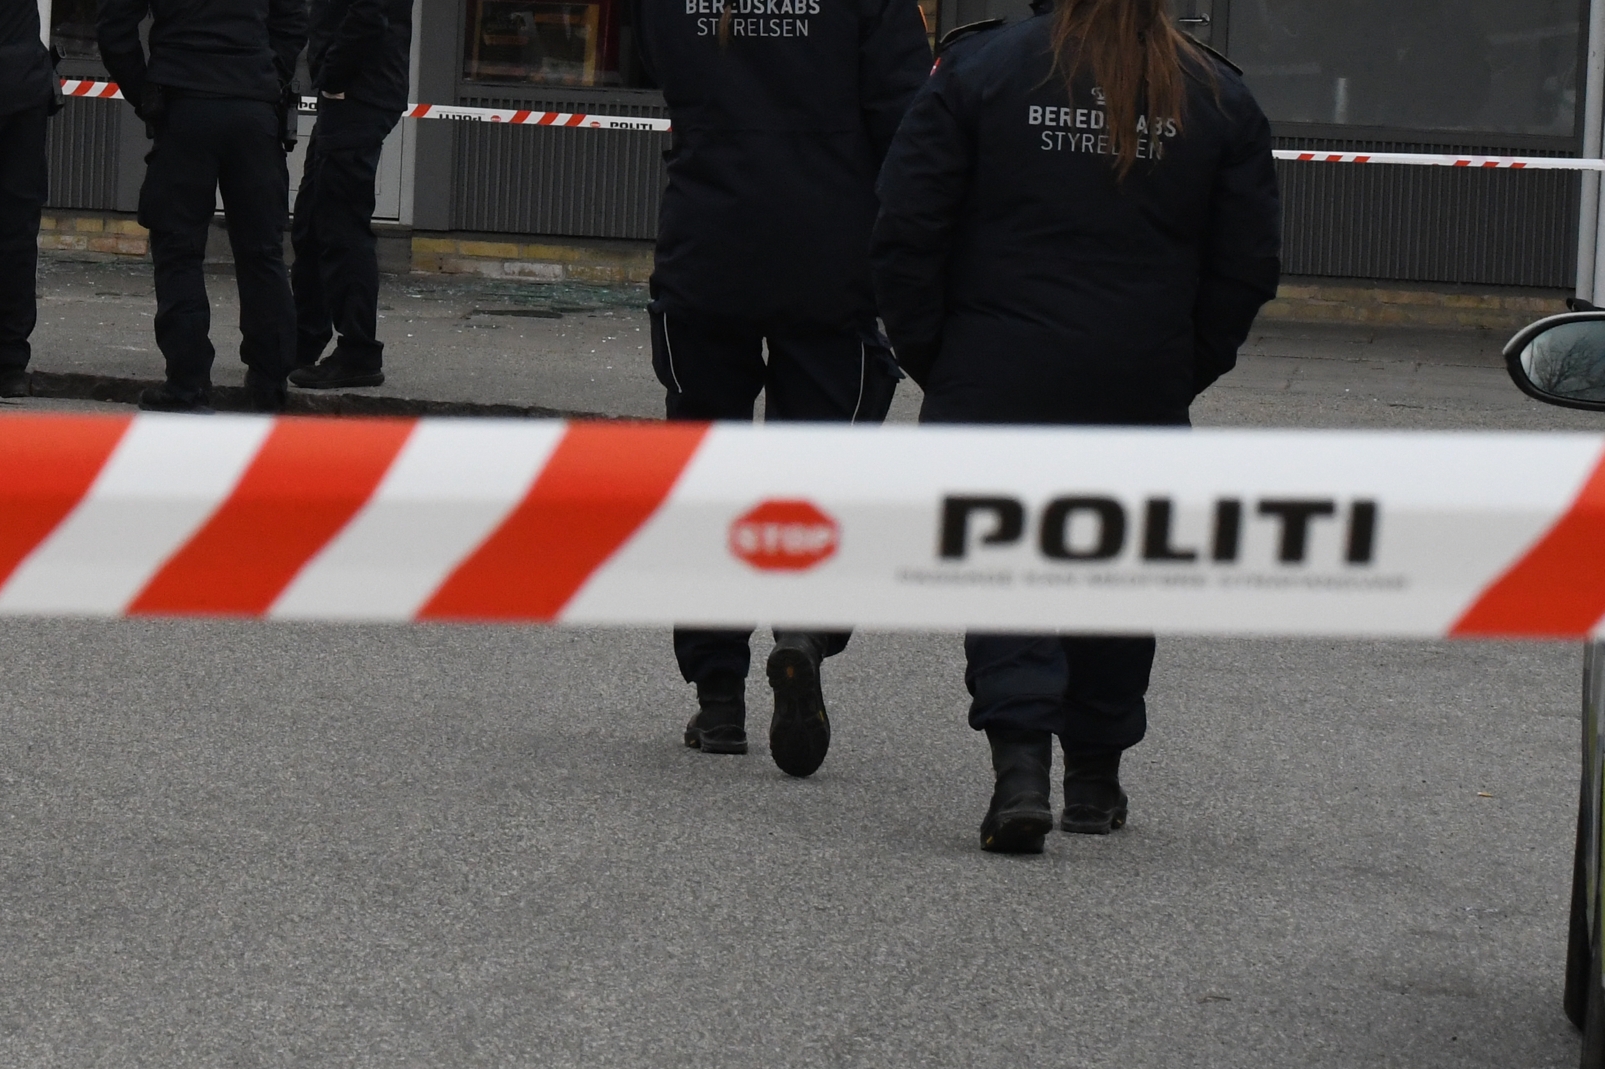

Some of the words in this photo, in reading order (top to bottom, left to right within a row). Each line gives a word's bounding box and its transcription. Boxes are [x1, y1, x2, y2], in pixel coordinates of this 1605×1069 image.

[697, 17, 809, 37] STRELSEN
[1040, 130, 1163, 160] STYRELEN
[936, 496, 1380, 565] POLITI
